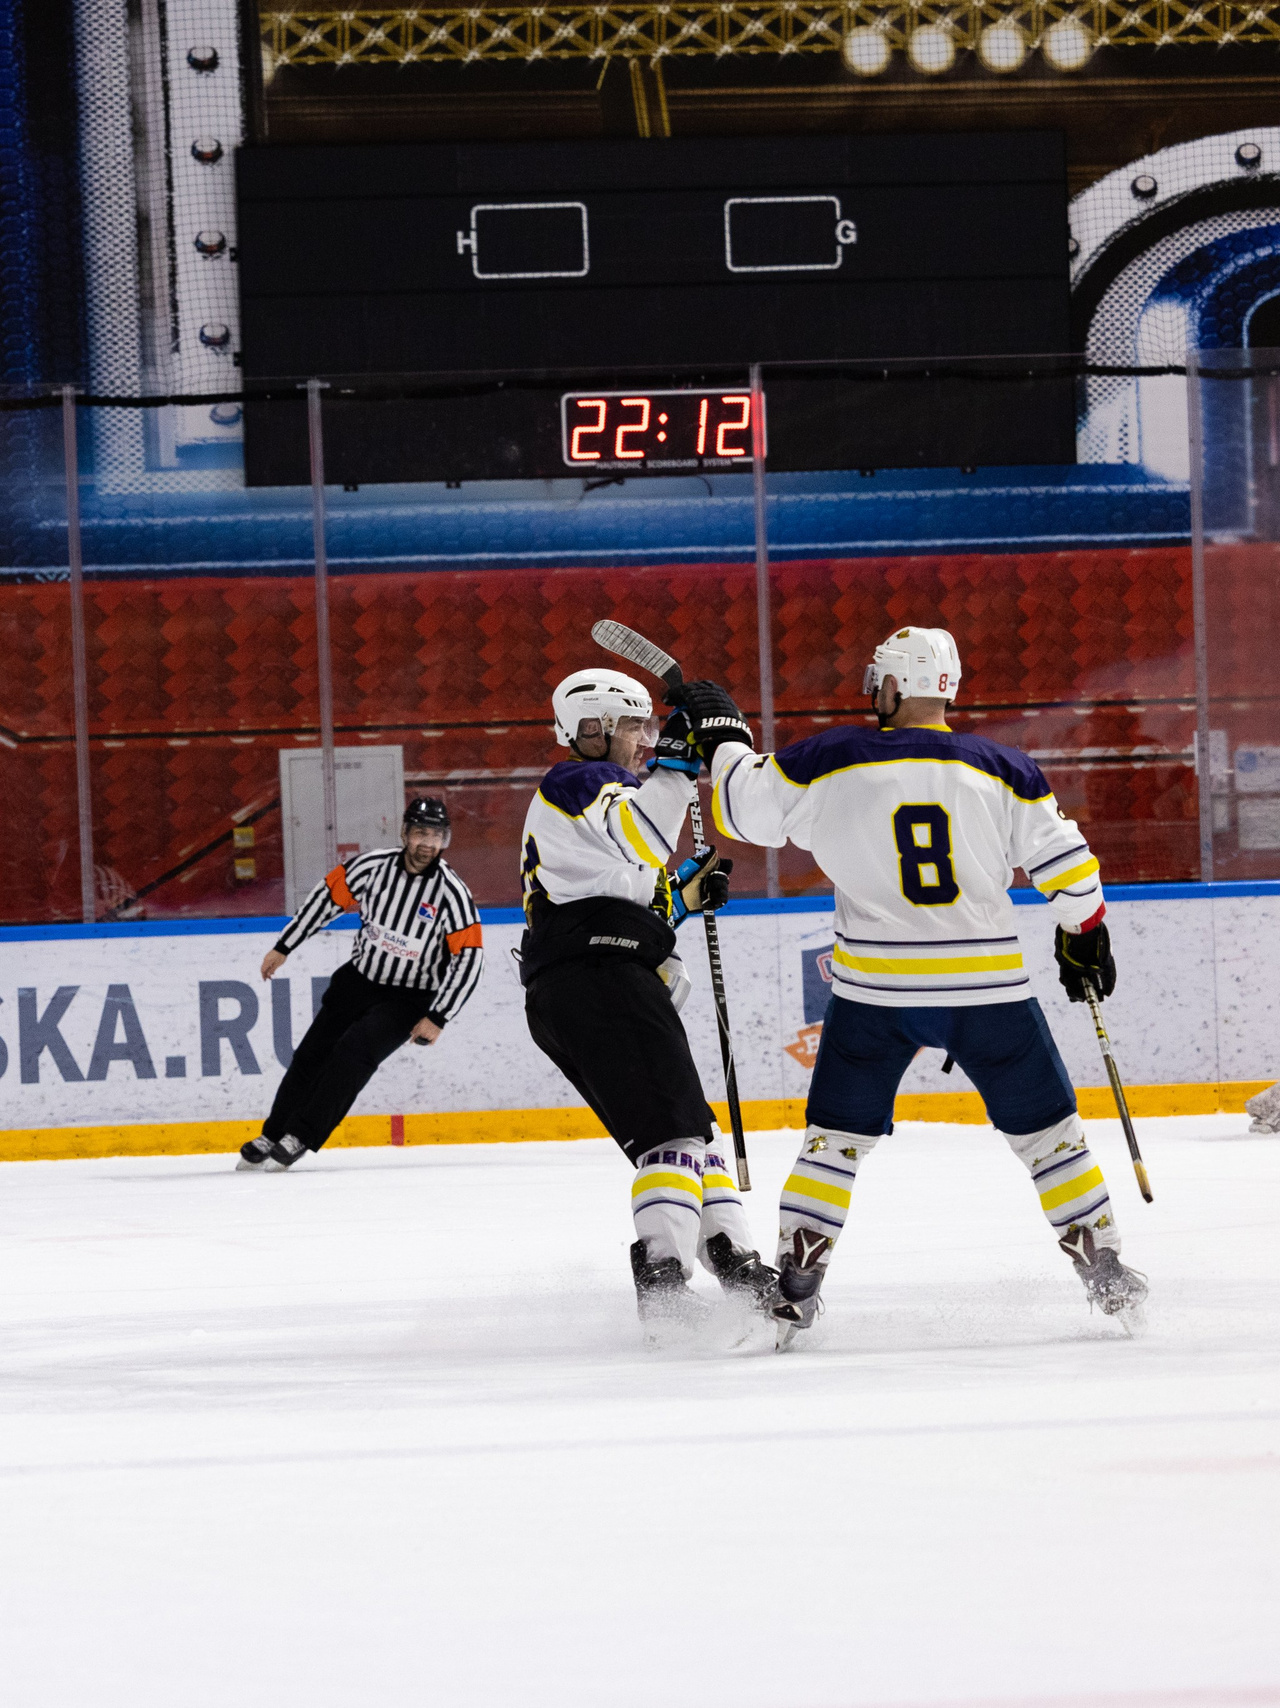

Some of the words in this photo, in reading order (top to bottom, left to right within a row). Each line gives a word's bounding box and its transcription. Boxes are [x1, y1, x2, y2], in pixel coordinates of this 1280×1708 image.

[835, 220, 857, 244] G
[457, 230, 477, 254] H
[571, 396, 751, 459] 22:12
[646, 459, 698, 469] SCOREBOARD
[702, 457, 732, 467] SYSTEM
[938, 673, 948, 692] 8
[891, 802, 962, 908] 8
[381, 940, 419, 957] РОССИЯ
[384, 932, 408, 947] БАНК
[589, 936, 639, 949] BAUER
